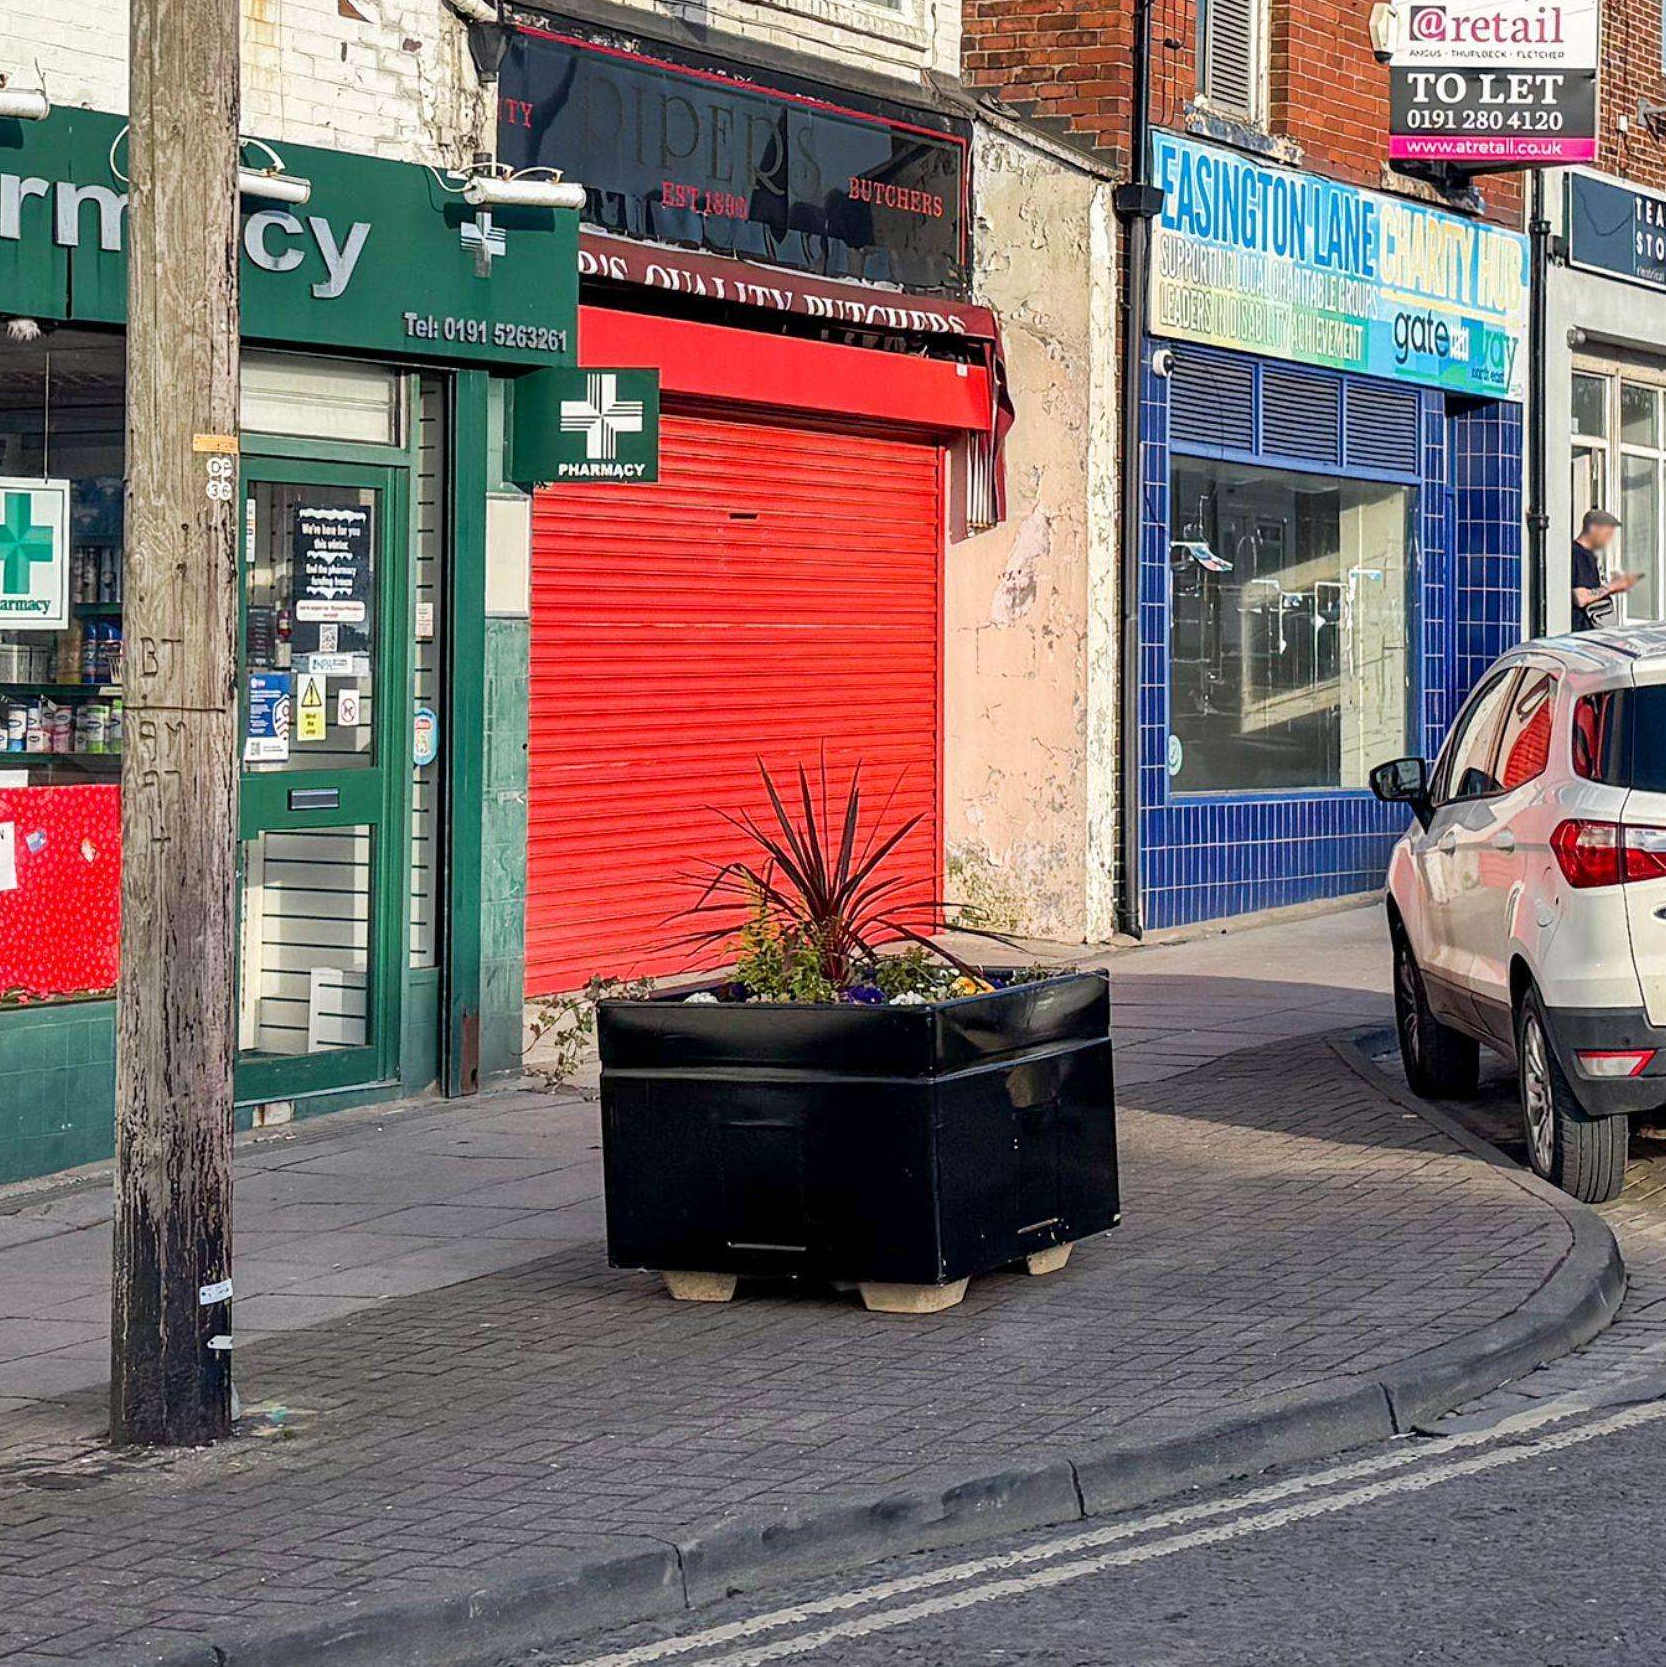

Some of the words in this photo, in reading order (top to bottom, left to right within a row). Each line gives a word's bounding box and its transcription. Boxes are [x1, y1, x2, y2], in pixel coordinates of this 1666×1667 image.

[1409, 6, 1565, 43] @retail
[1407, 73, 1467, 104] TO
[1478, 74, 1564, 104] LET
[1407, 109, 1457, 129] 0191
[1462, 110, 1503, 130] 280
[1507, 111, 1563, 130] 4120
[1406, 139, 1562, 155] www.atretail.co.uk
[848, 176, 943, 218] BUTCHERS
[1160, 143, 1307, 263] EASINGTON
[1312, 185, 1376, 278] LANE
[1160, 234, 1236, 290] SUPPORTING
[1338, 276, 1378, 321] GROUPS
[1380, 203, 1475, 303] CHARITY
[1477, 229, 1523, 312] HUB
[1159, 281, 1212, 333] LEADERS
[403, 312, 438, 339] Tel:
[444, 317, 487, 344] 0191
[494, 322, 567, 352] 5263261
[558, 464, 646, 479] PHARMACY
[140, 637, 183, 681] BT
